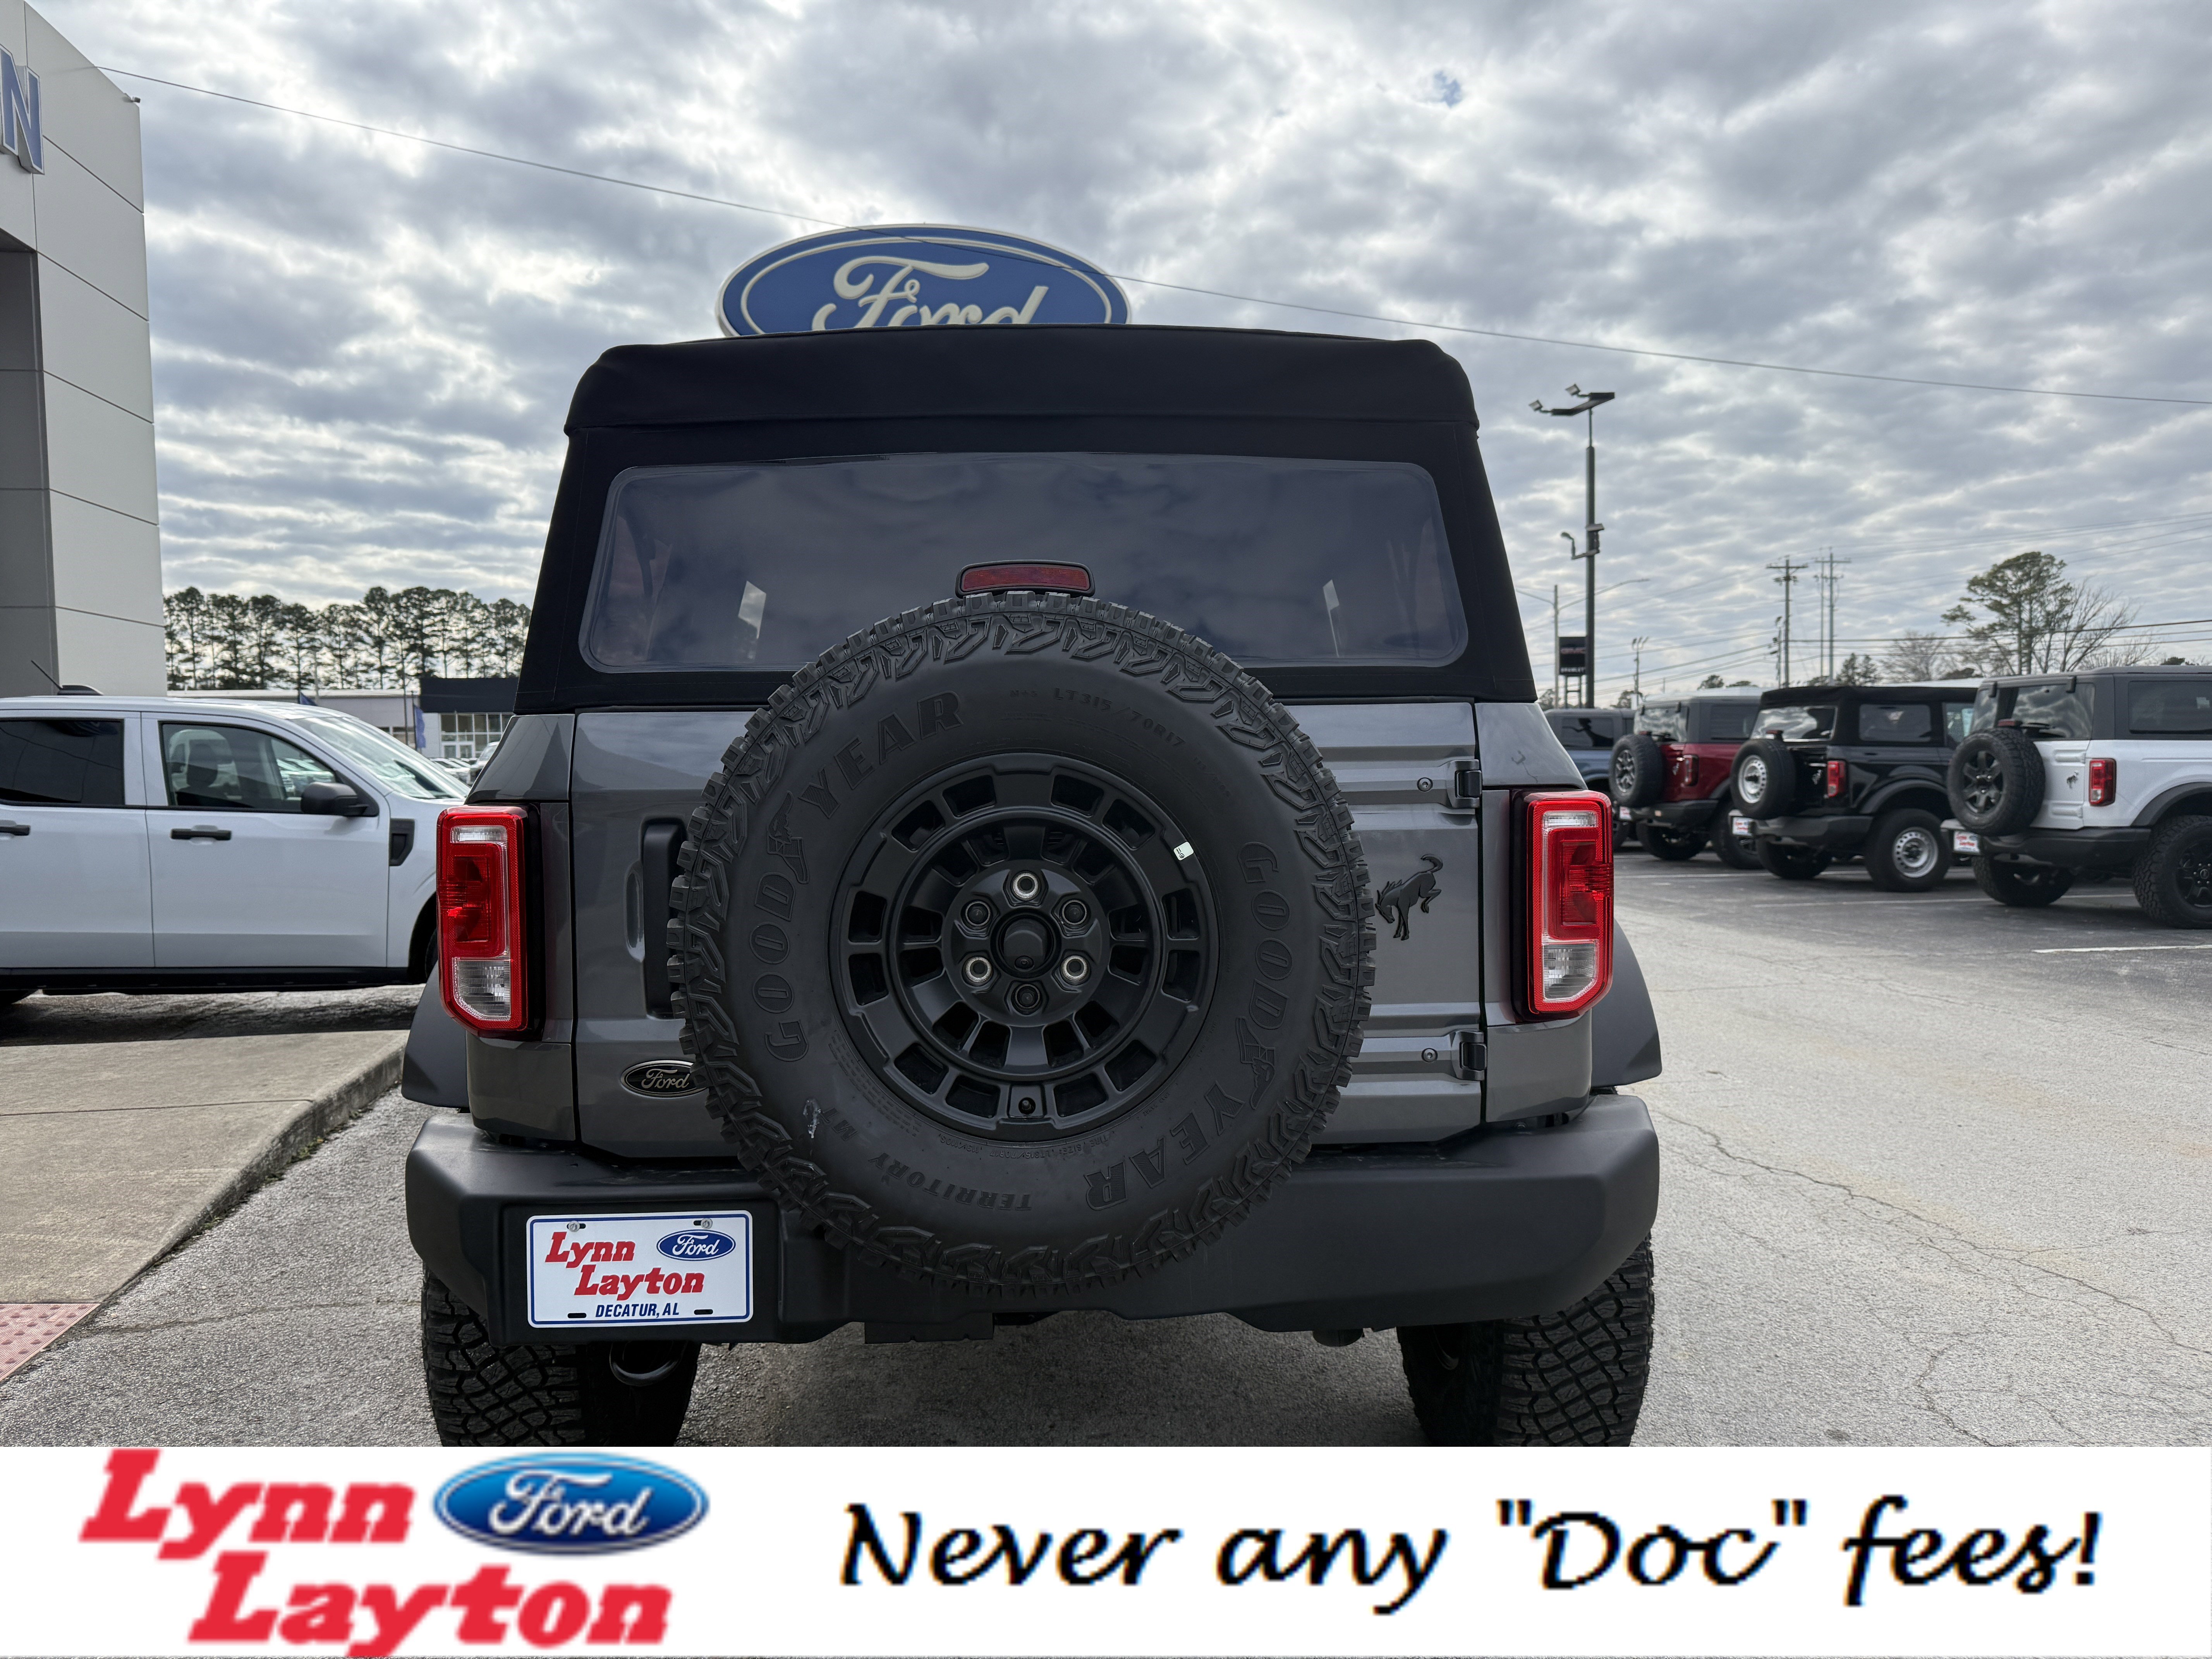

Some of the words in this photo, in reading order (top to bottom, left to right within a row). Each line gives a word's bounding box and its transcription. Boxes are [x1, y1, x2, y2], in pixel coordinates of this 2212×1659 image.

[811, 255, 1049, 329] Ford
[641, 1068, 689, 1090] Ford
[868, 1152, 1033, 1211] TERRITORY
[545, 1232, 635, 1268] Lynn
[672, 1233, 720, 1256] Ford
[574, 1264, 704, 1301] Layton
[662, 1303, 680, 1316] AL
